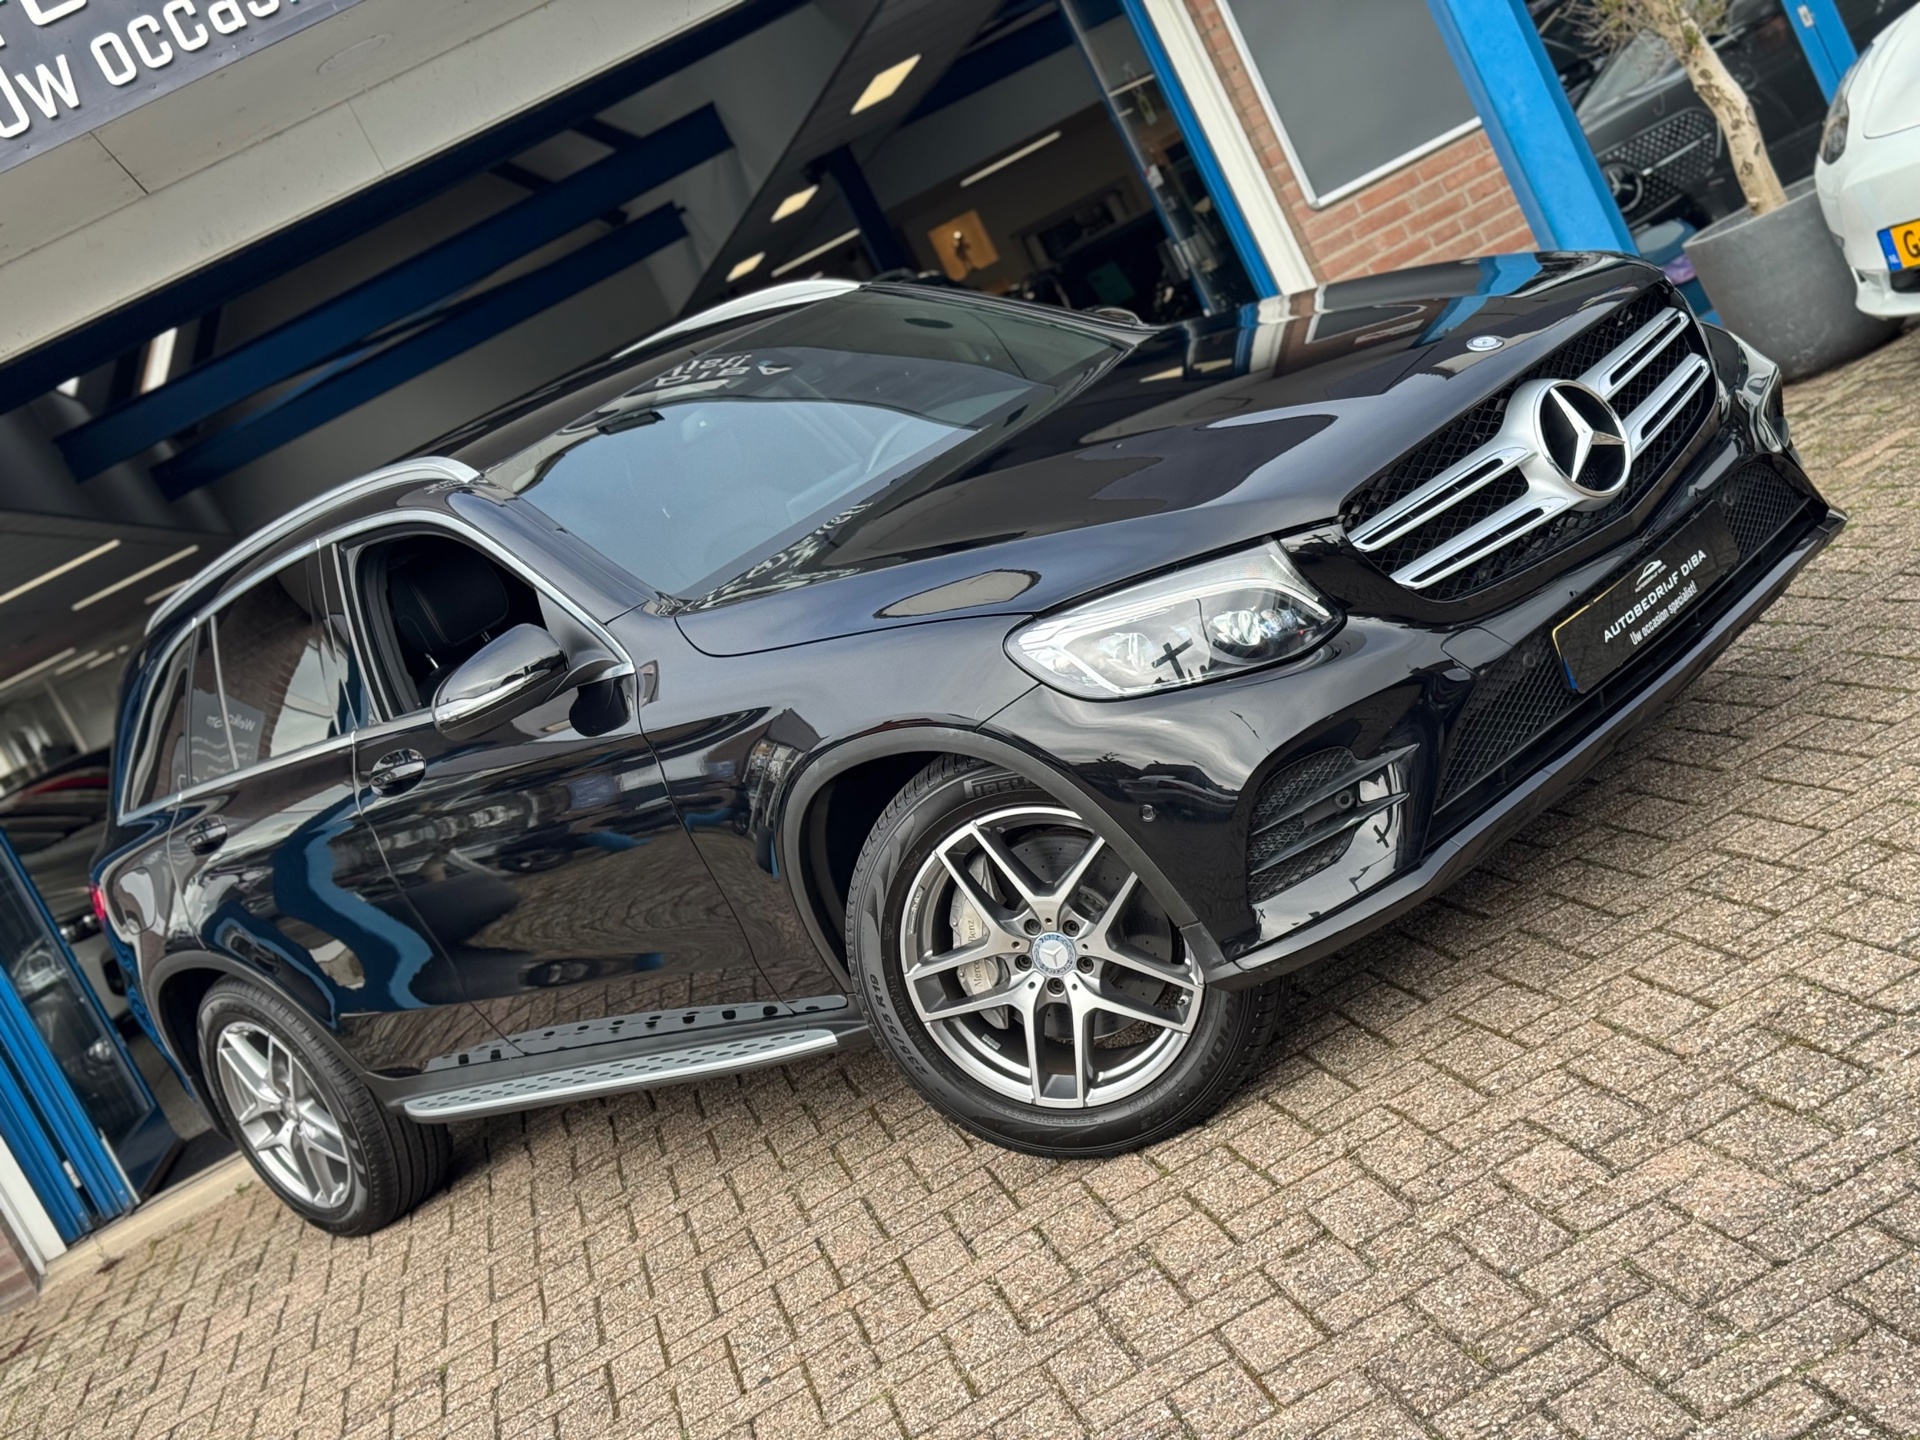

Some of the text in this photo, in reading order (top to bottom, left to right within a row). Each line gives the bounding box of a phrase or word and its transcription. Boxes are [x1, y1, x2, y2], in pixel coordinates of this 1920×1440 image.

[88, 0, 281, 86] occa
[1603, 571, 1679, 643] AUTOBEDRIJF
[1680, 549, 1707, 577] DIBA
[1629, 579, 1699, 646] Uw occasion specialist!
[881, 1012, 930, 1075] 235/55
